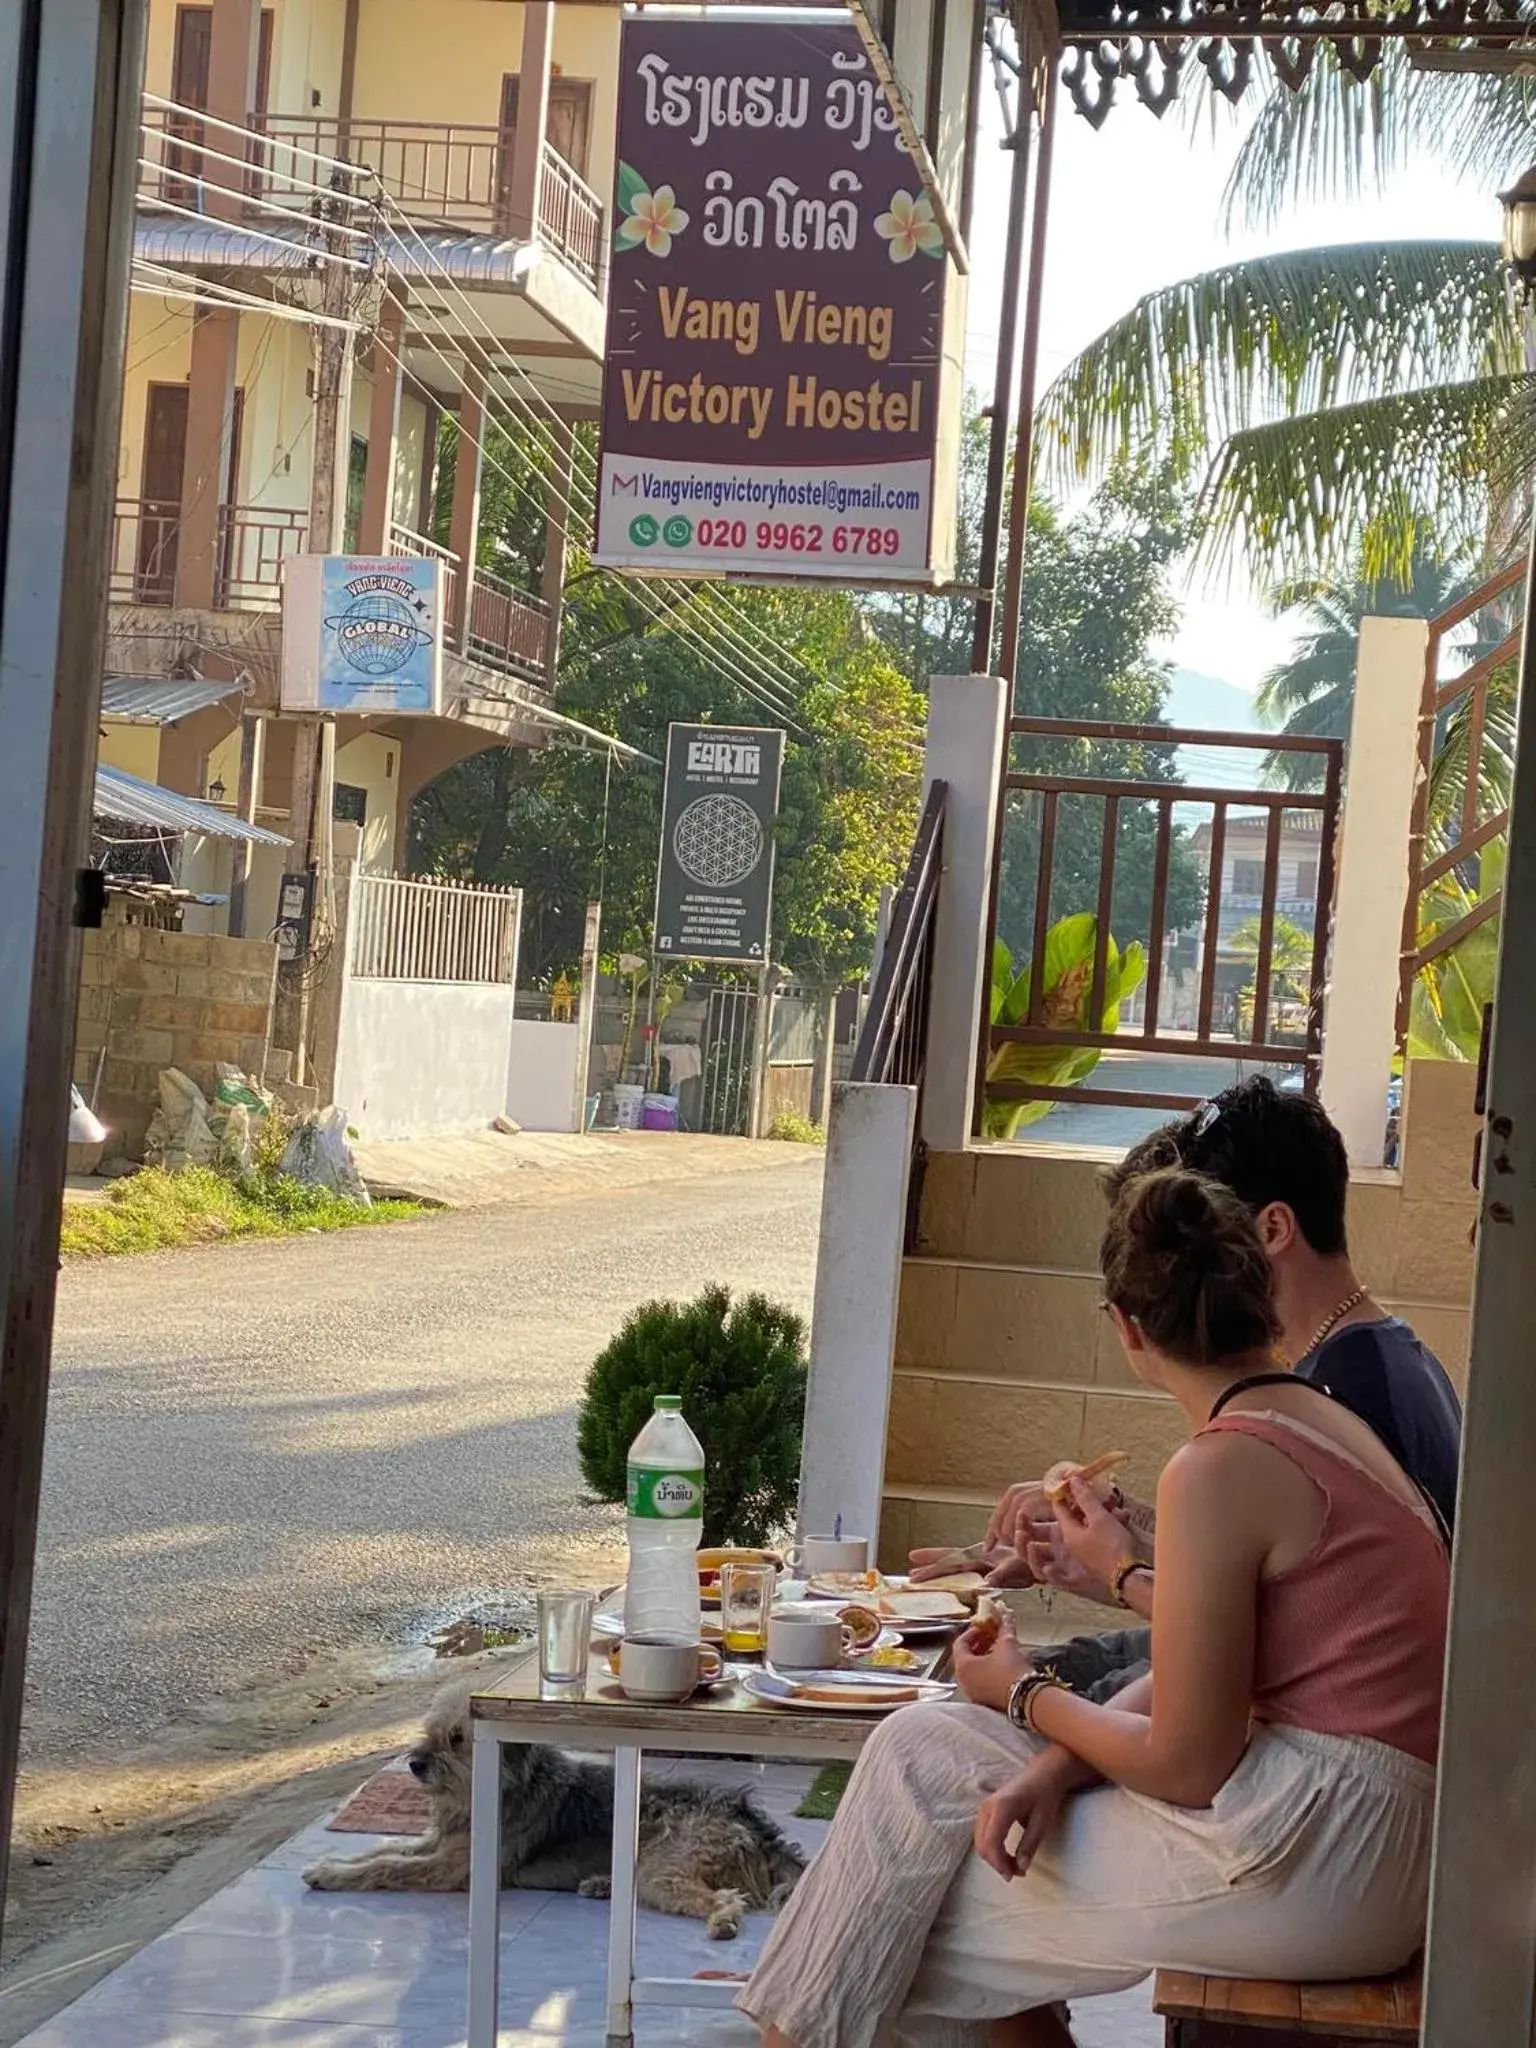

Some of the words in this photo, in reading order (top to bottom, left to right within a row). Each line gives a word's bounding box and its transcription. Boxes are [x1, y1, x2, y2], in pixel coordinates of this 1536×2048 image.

[658, 286, 760, 356] Vang
[774, 288, 894, 361] Vieng
[621, 369, 773, 440] Victory
[786, 375, 922, 433] Hostel
[642, 472, 920, 512] Vangviengvictoryhostel@gmail.com
[697, 518, 747, 548] 020
[756, 522, 822, 553] 9962
[832, 525, 900, 556] 6789
[344, 621, 408, 639] GLOBAL
[687, 742, 761, 775] EARTH
